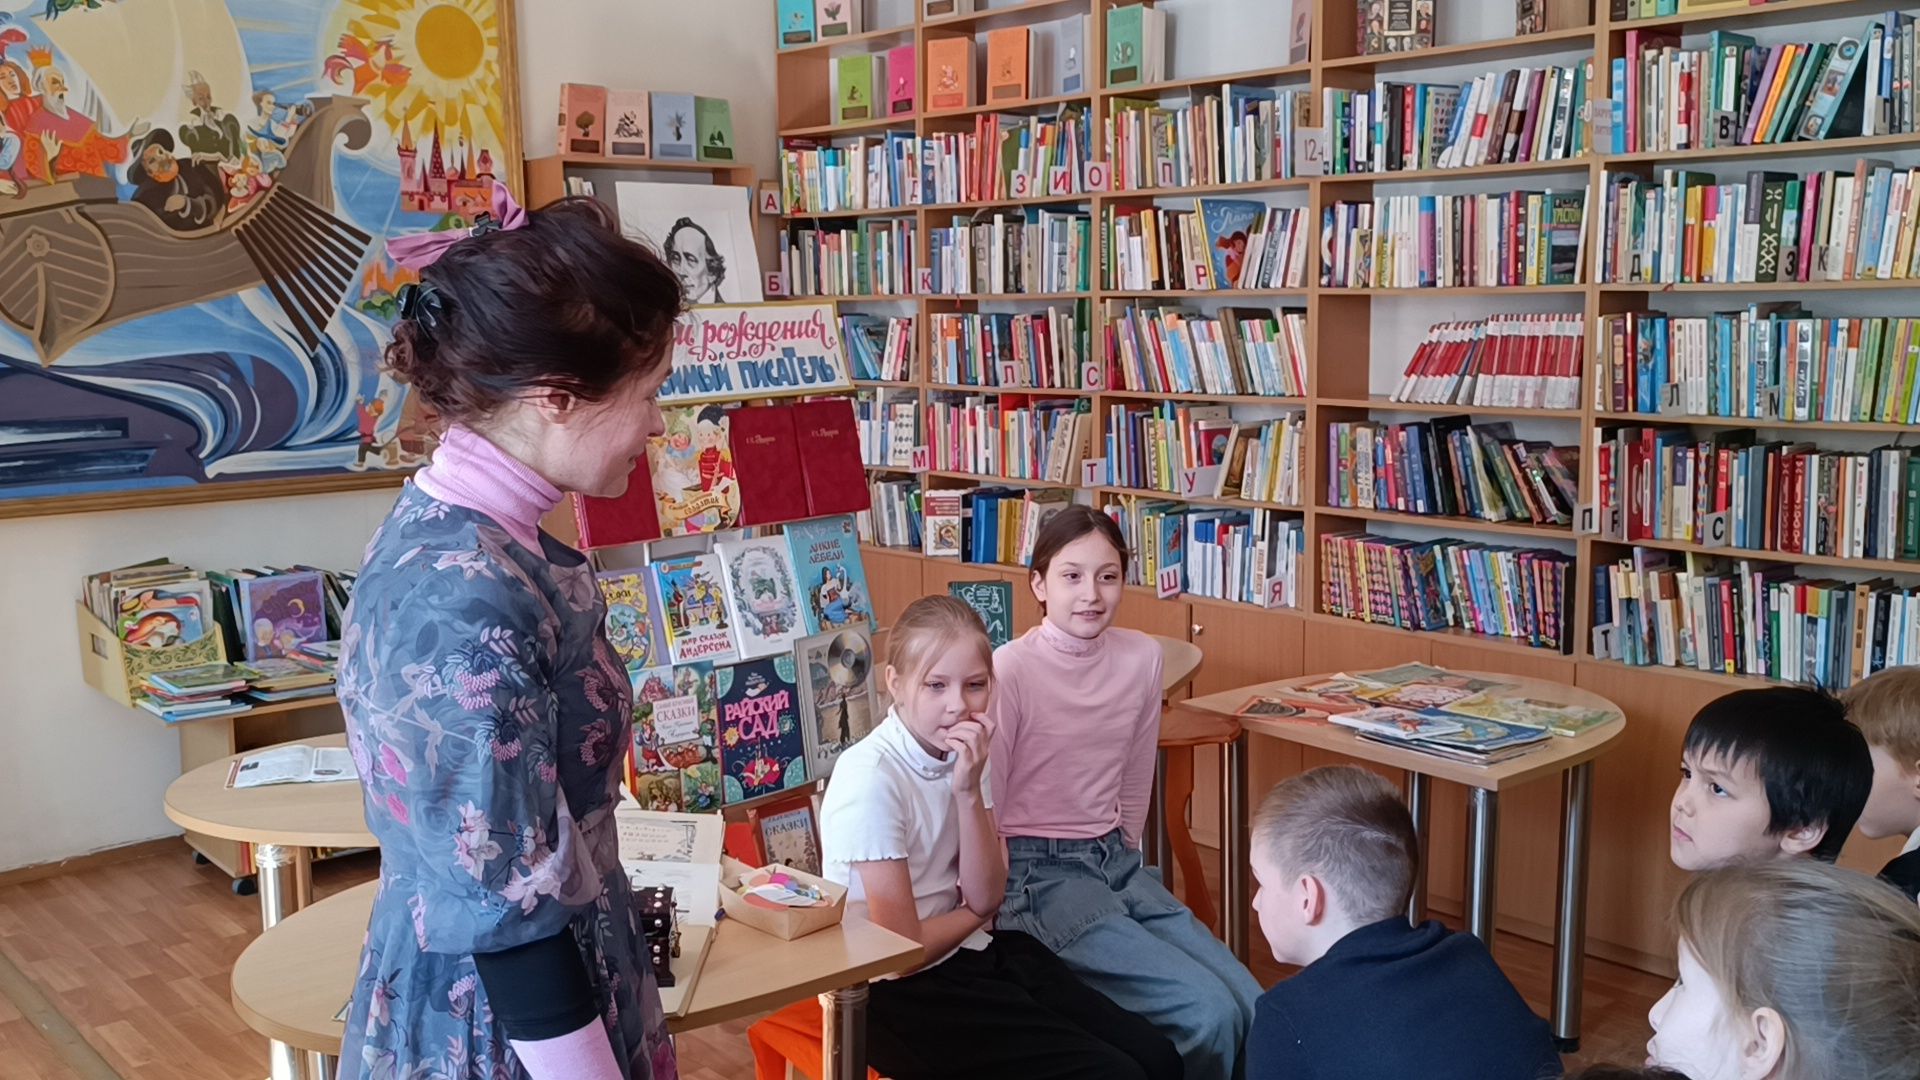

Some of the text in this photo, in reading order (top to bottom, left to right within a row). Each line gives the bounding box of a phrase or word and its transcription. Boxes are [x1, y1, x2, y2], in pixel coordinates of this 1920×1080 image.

[1719, 115, 1730, 139] В
[1016, 174, 1026, 194] З
[1054, 171, 1066, 190] И
[1089, 166, 1102, 187] О
[1161, 162, 1173, 184] П
[765, 193, 778, 211] А
[1630, 254, 1642, 281] Д
[1785, 251, 1796, 276] З
[1818, 246, 1829, 271] К
[768, 275, 780, 292] Б
[1195, 265, 1207, 285] Р
[1003, 365, 1015, 384] Л
[1086, 366, 1098, 387] С
[1668, 384, 1680, 407] Л
[913, 451, 926, 468] М
[1087, 463, 1097, 482] Т
[1184, 471, 1196, 493] У
[1582, 508, 1593, 531] П
[1712, 516, 1724, 540] С
[1161, 568, 1178, 593] Ш
[1271, 581, 1283, 603] Я
[679, 640, 732, 659] АНДЕРСЕНА
[1601, 629, 1610, 651] Т
[656, 706, 696, 723] СКАЗКИ
[724, 689, 790, 722] РАЙСКИЙ
[738, 711, 780, 740] САД
